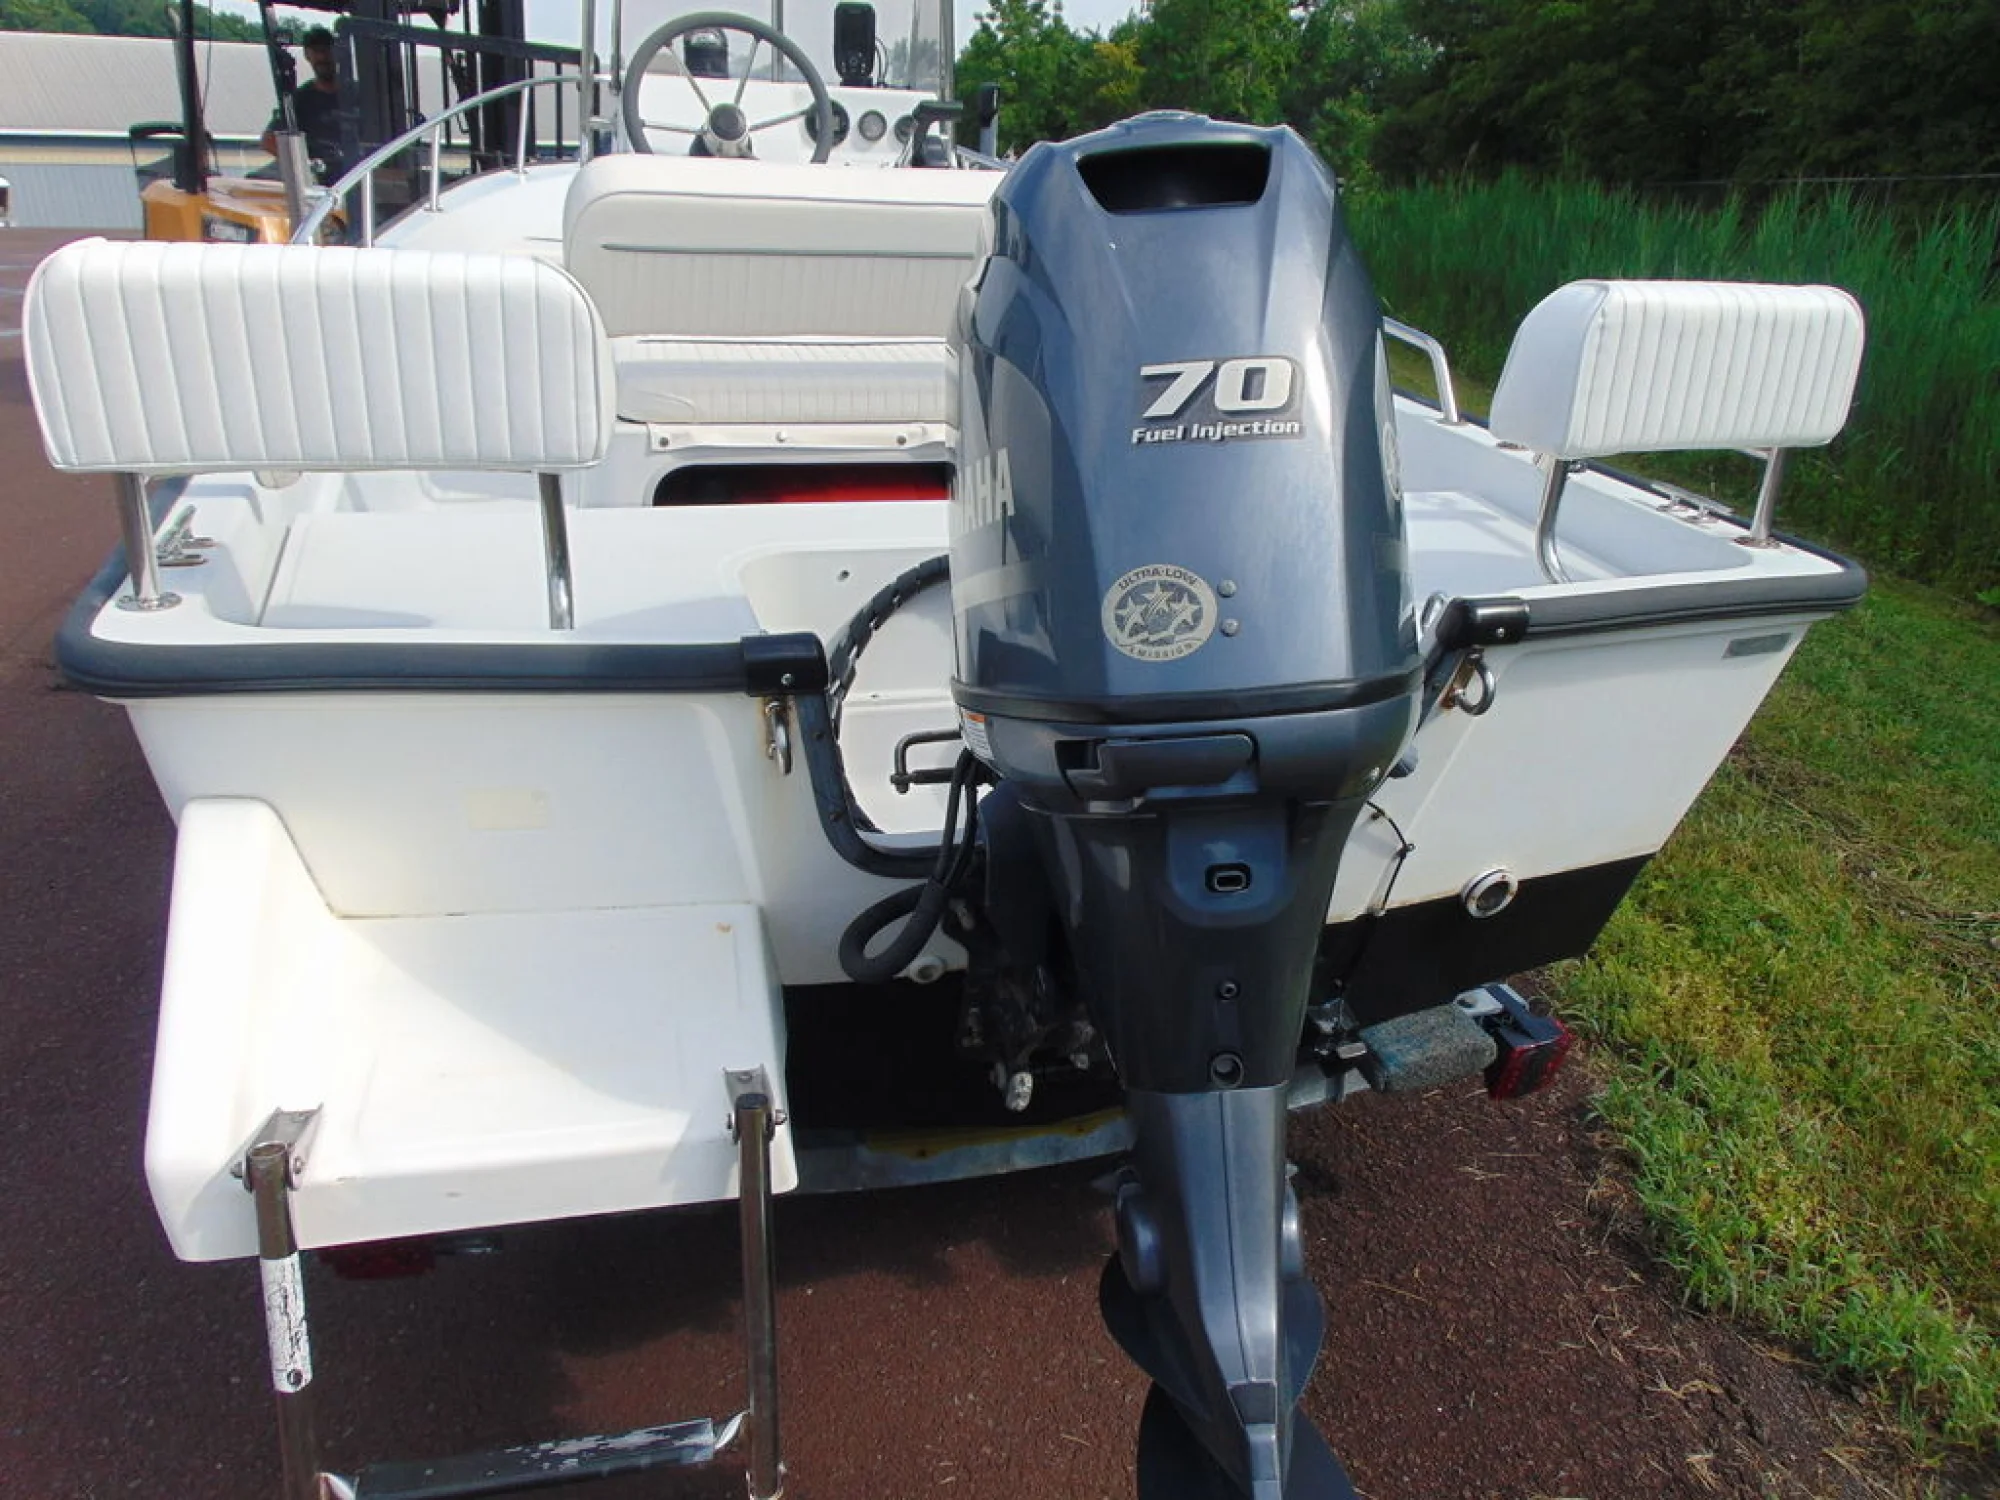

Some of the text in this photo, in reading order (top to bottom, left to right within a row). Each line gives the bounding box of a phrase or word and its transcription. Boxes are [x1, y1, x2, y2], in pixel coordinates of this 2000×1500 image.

[1140, 358, 1292, 418] 70
[1131, 419, 1300, 445] Fuel Injection
